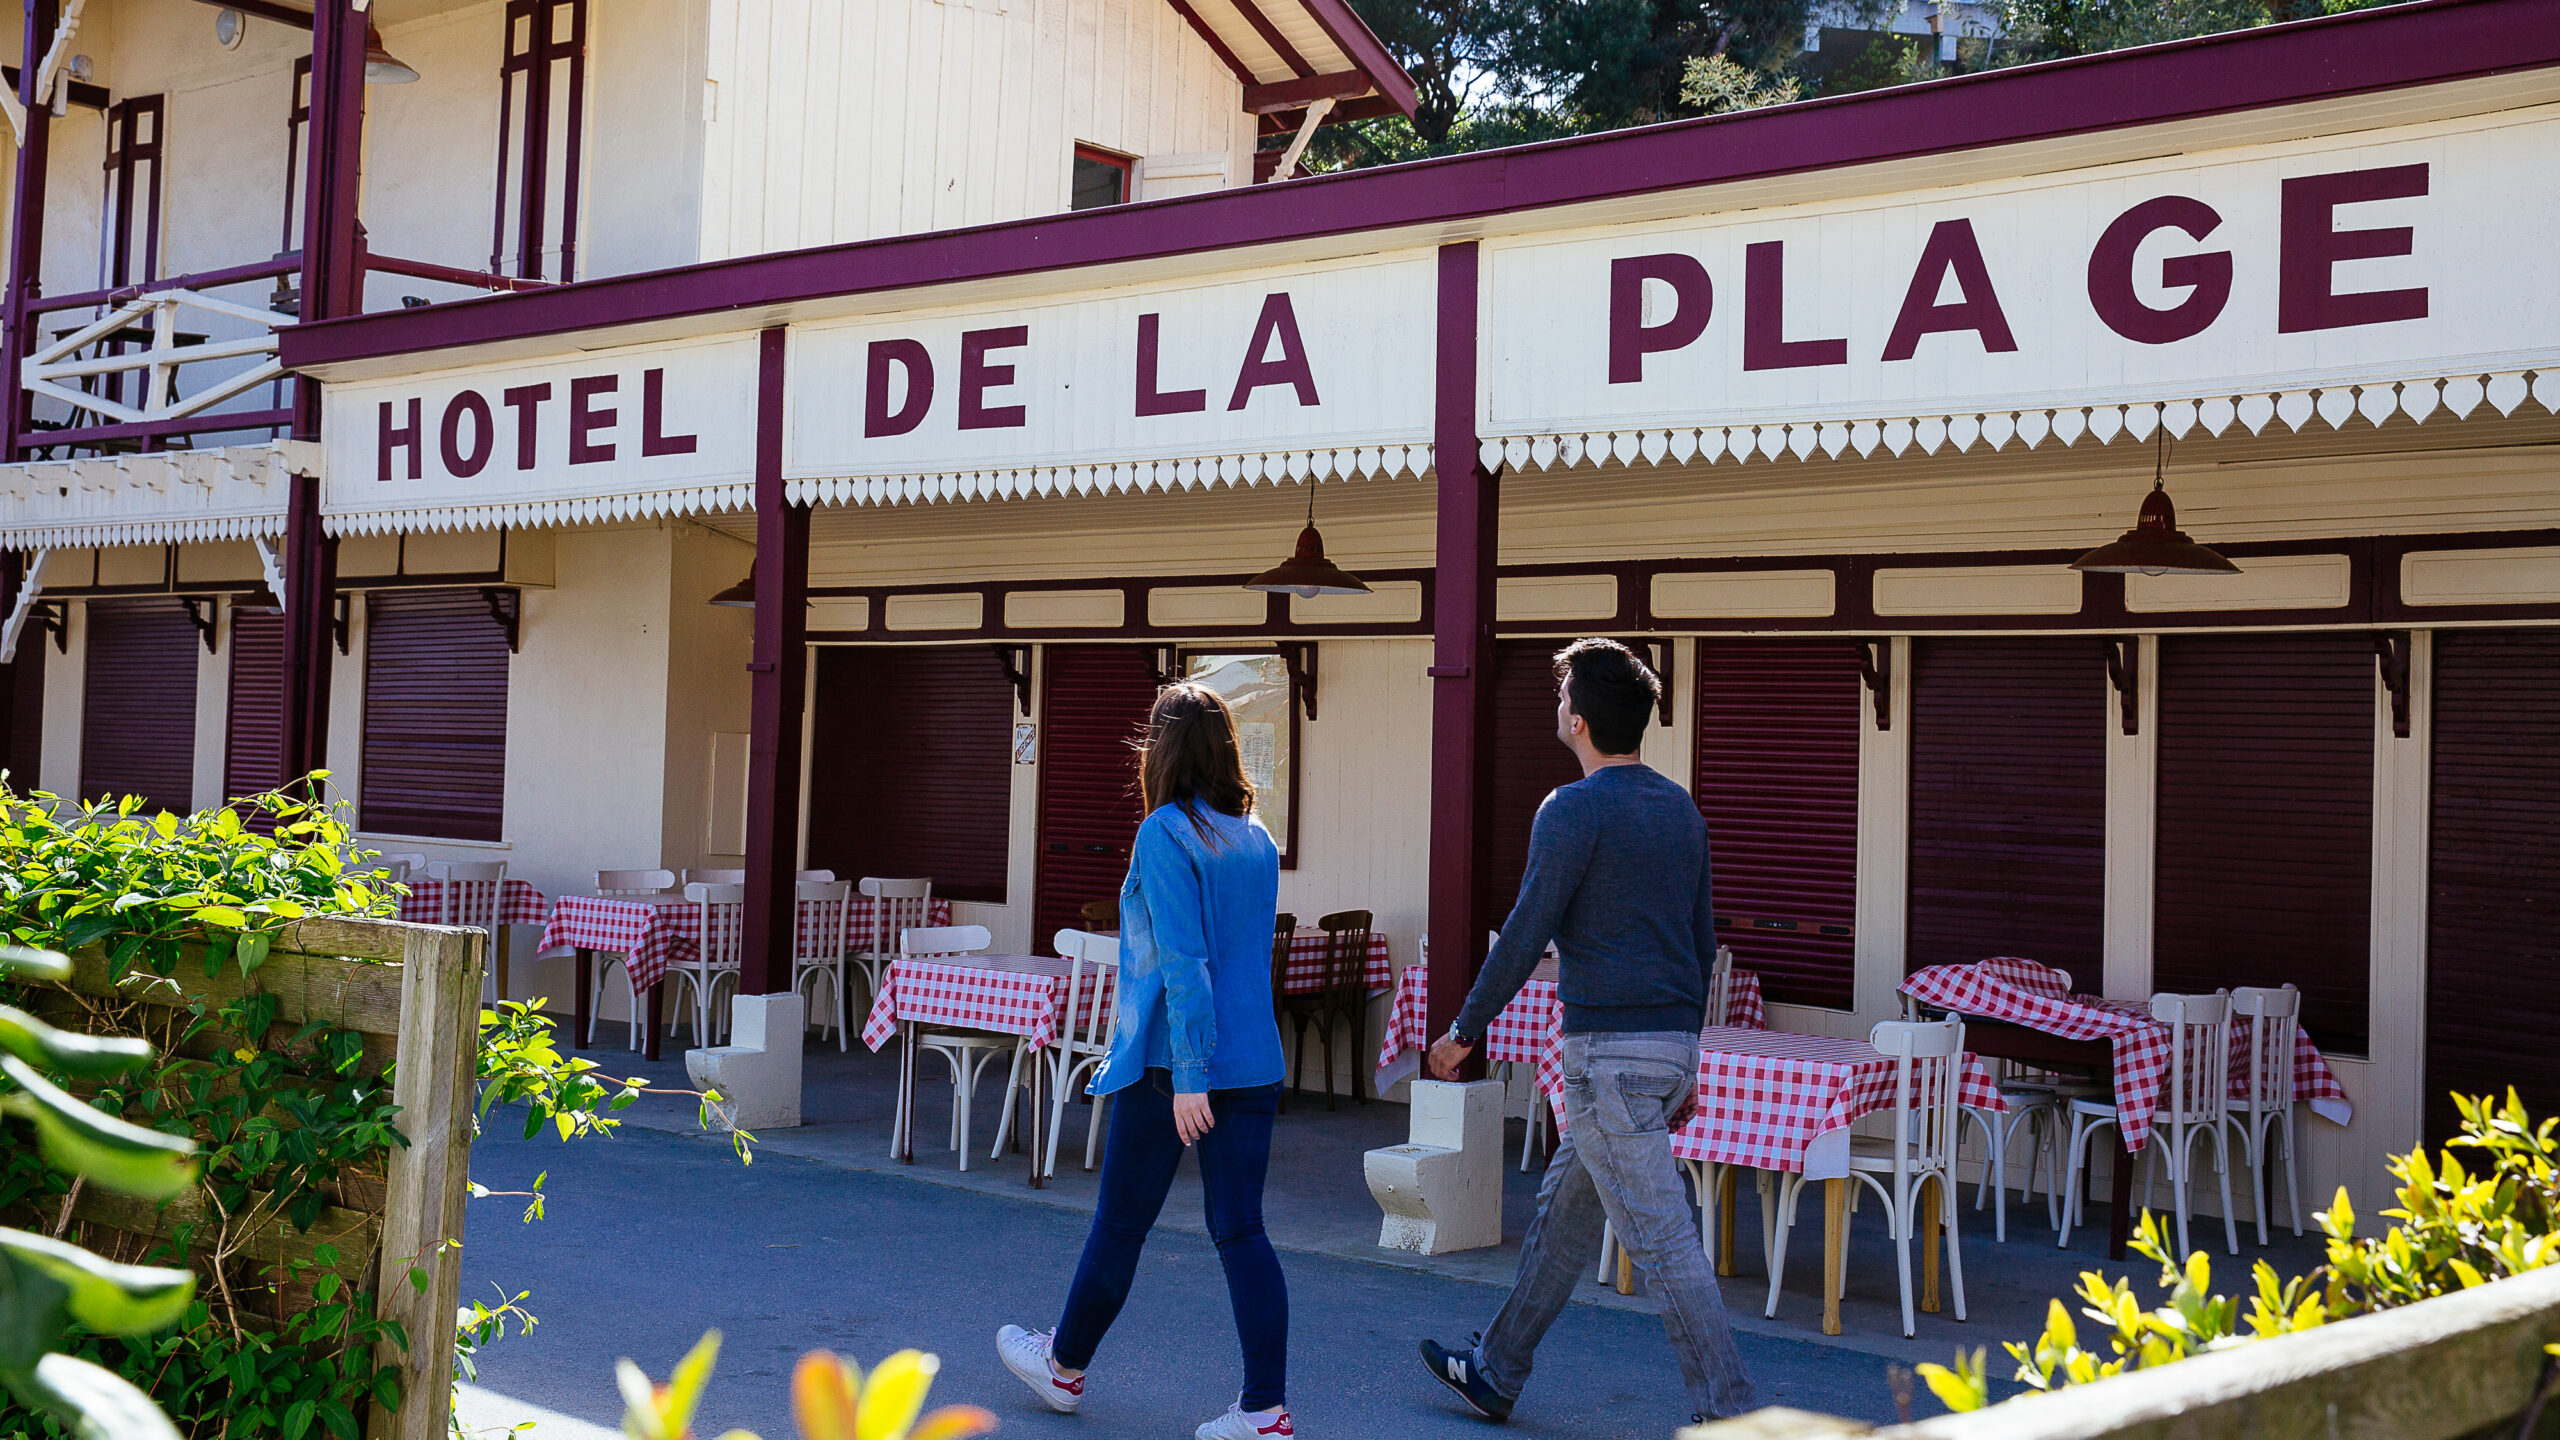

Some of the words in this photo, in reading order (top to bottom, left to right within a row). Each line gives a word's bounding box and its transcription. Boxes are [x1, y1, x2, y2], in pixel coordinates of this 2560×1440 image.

[378, 368, 698, 482] HOTEL
[865, 325, 1029, 438] DE
[1136, 293, 1321, 417] LA
[1609, 163, 2430, 384] PLAGE
[1447, 1356, 1467, 1384] N
